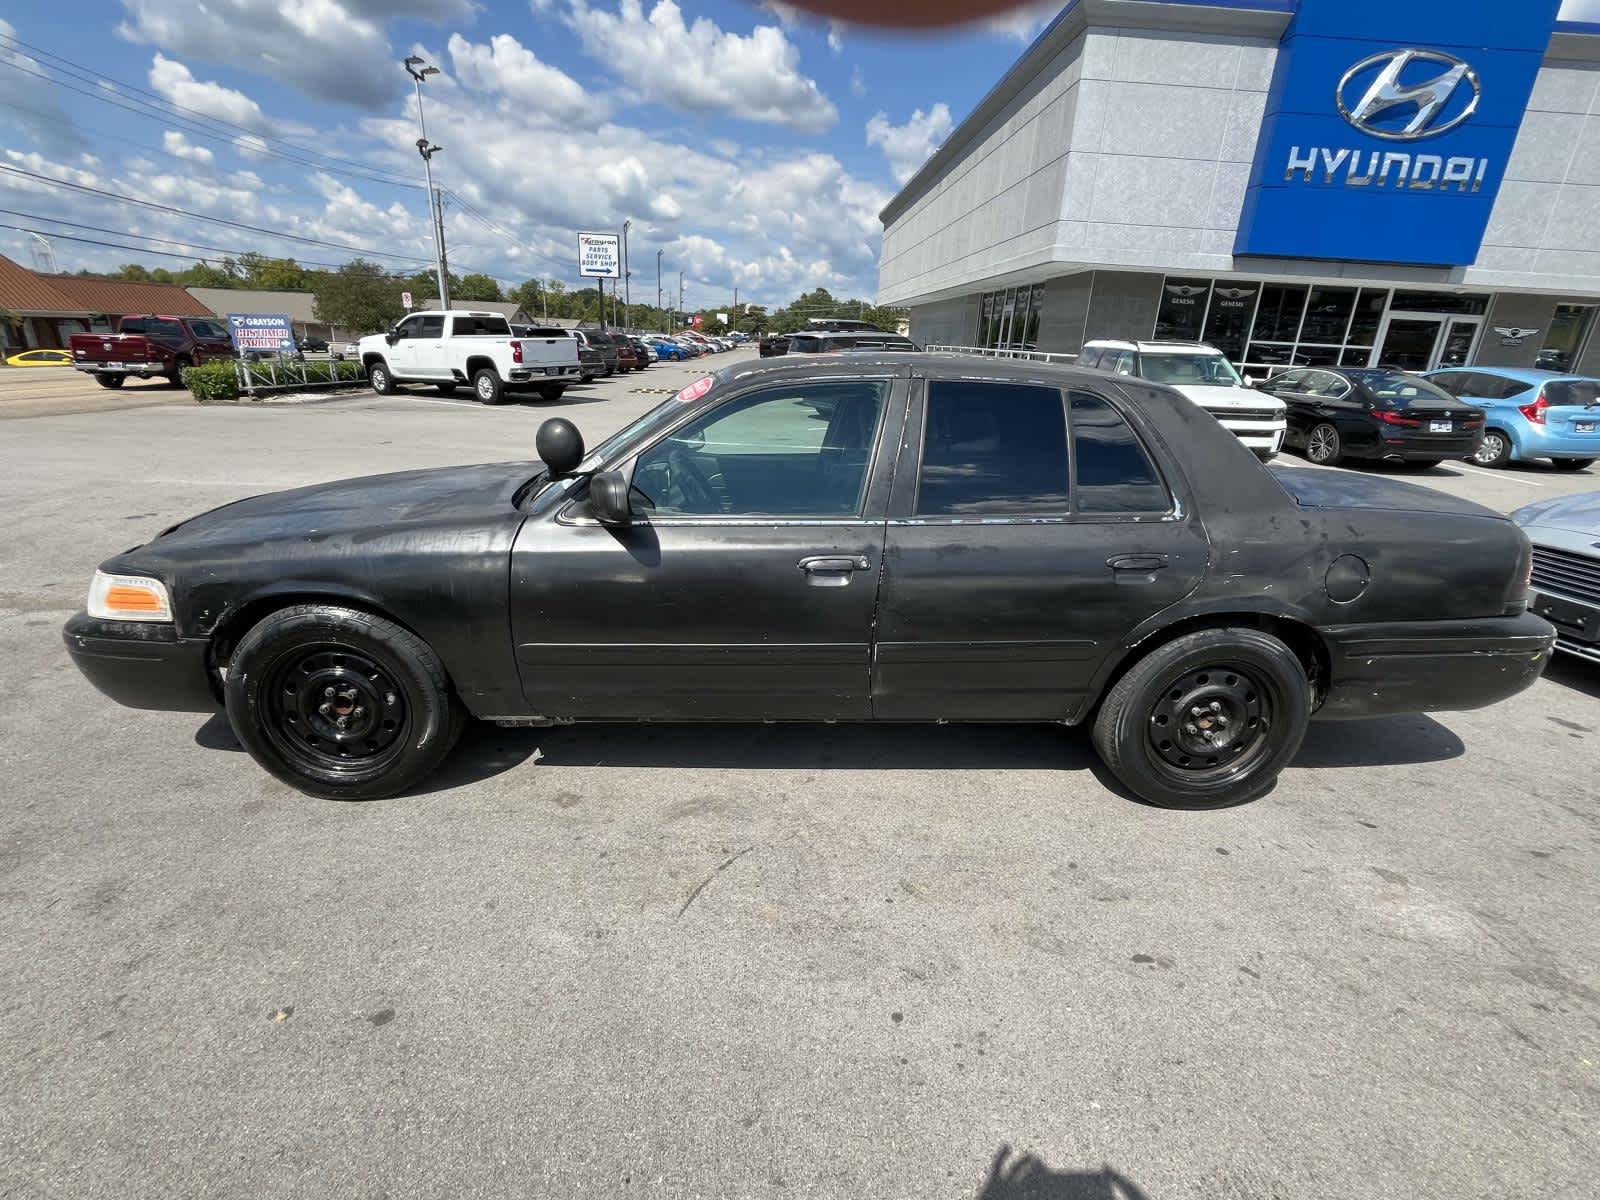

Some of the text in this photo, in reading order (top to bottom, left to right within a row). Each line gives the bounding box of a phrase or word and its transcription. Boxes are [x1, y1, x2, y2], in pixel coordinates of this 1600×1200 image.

[1284, 146, 1488, 193] HYUNDAI
[1171, 297, 1195, 305] GENESIS
[1220, 300, 1244, 308] GENESIS
[246, 317, 285, 326] GRAYSON
[235, 328, 289, 339] CUSTOMER
